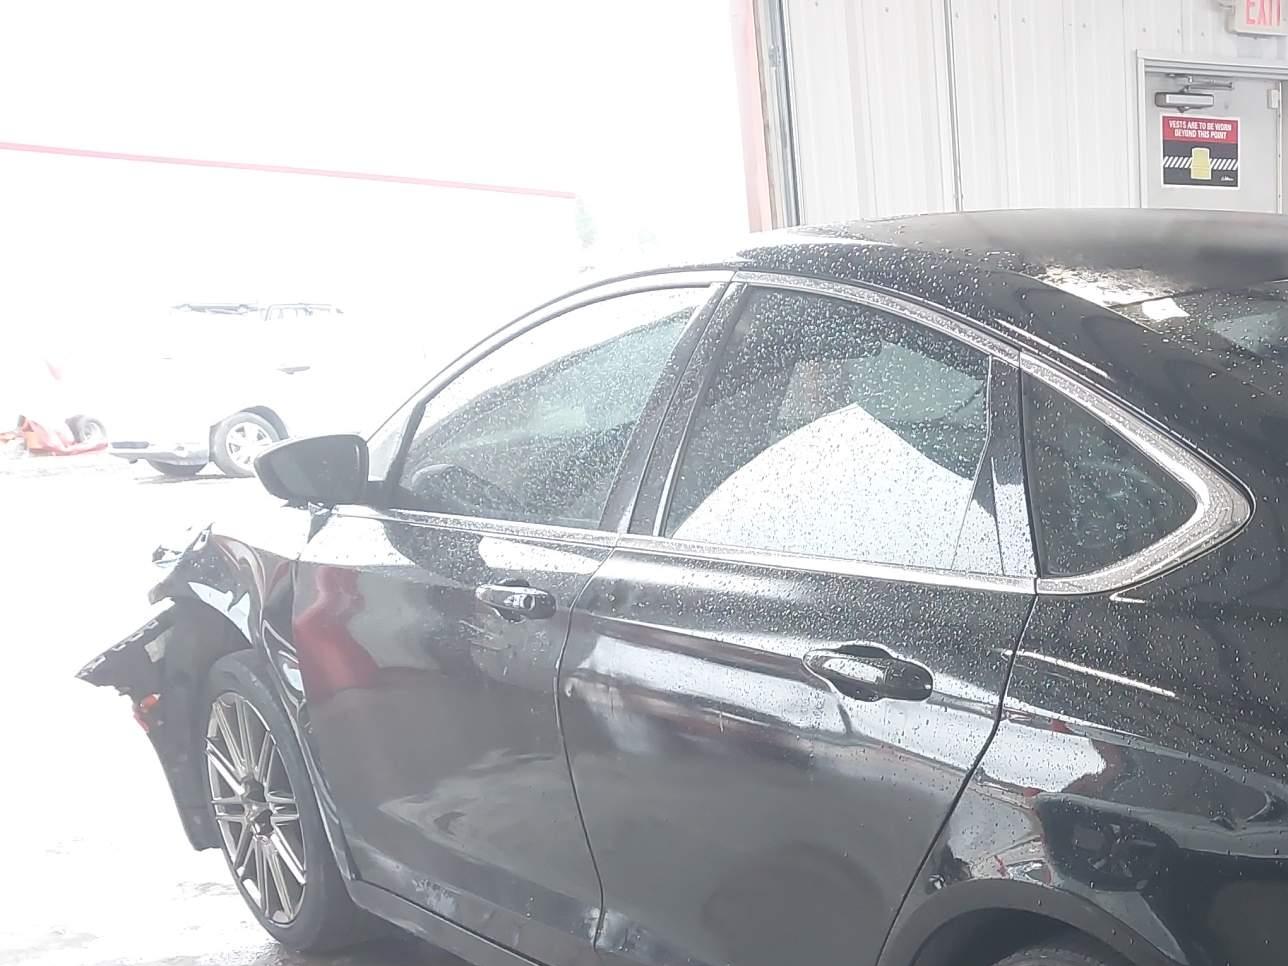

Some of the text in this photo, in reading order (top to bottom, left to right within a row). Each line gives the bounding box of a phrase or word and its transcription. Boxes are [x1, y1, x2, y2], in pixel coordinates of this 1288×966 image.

[1168, 120, 1232, 131] VESTS ARE TO BE WORN
[1174, 129, 1197, 138] BEYOND
